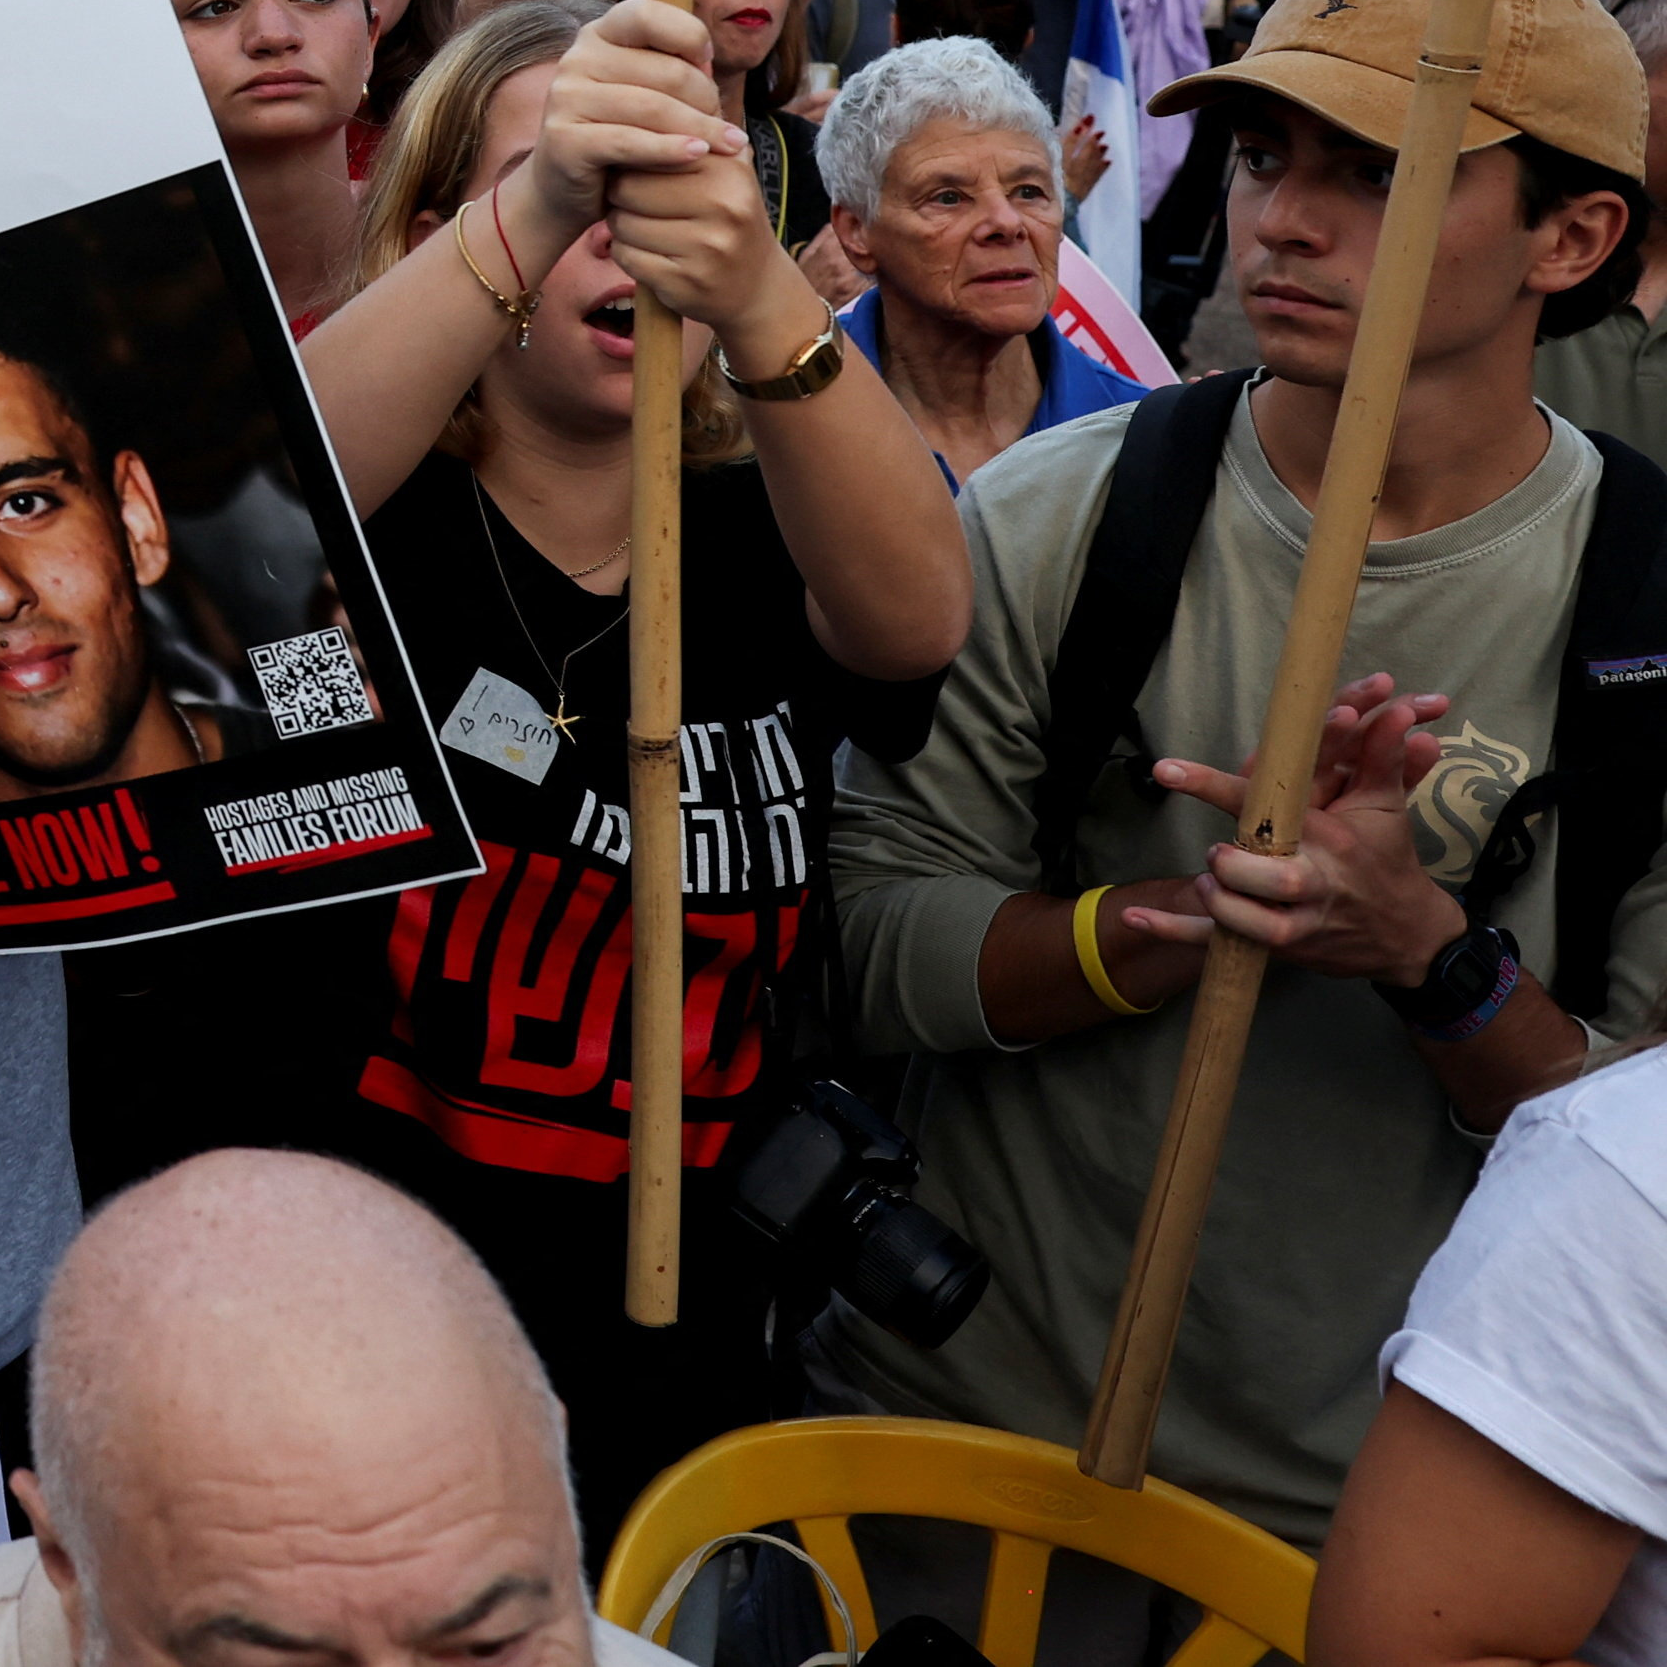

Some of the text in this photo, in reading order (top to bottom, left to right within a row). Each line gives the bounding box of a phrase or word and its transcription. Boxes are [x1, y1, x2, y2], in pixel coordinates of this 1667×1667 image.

[1599, 666, 1667, 685] patagoni
[8, 787, 160, 882] NOW!
[204, 767, 407, 832] HOSTAGES AND MISSING
[213, 793, 425, 868] FAMILIES FORUM
